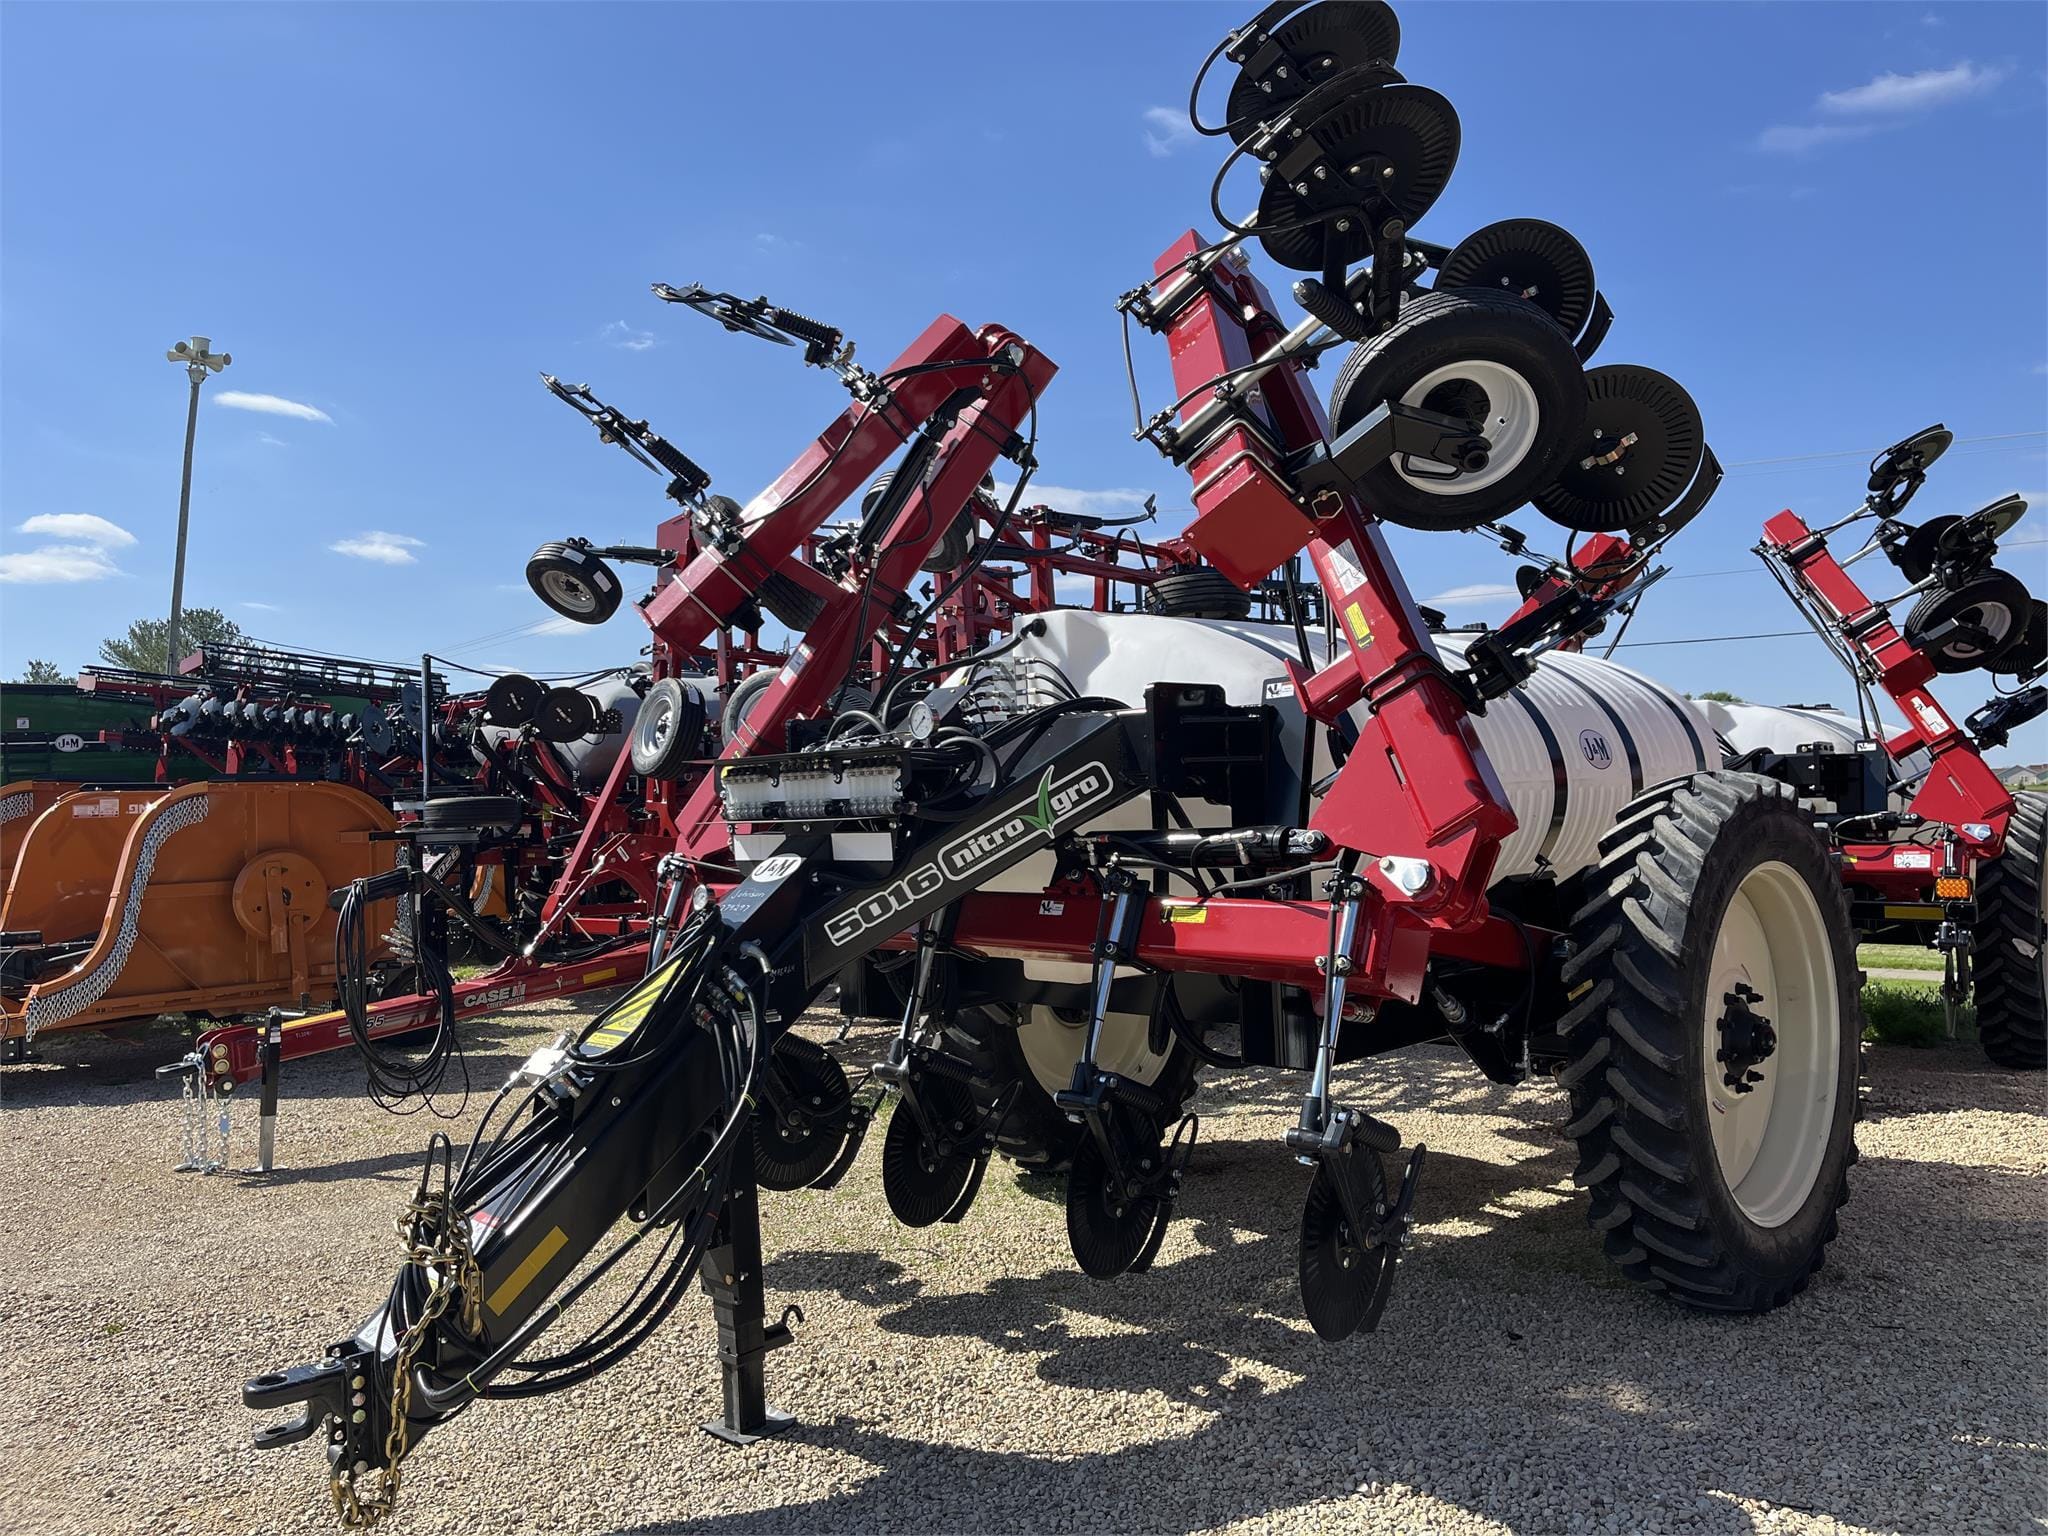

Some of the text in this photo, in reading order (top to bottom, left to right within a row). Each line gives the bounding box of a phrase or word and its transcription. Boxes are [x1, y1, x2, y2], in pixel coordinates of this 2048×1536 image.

[1583, 737, 1610, 761] J&M
[951, 817, 1025, 869] nitro
[1051, 774, 1100, 815] gro
[754, 859, 797, 877] J&M
[824, 862, 944, 947] 5016
[463, 987, 511, 1008] CASE
